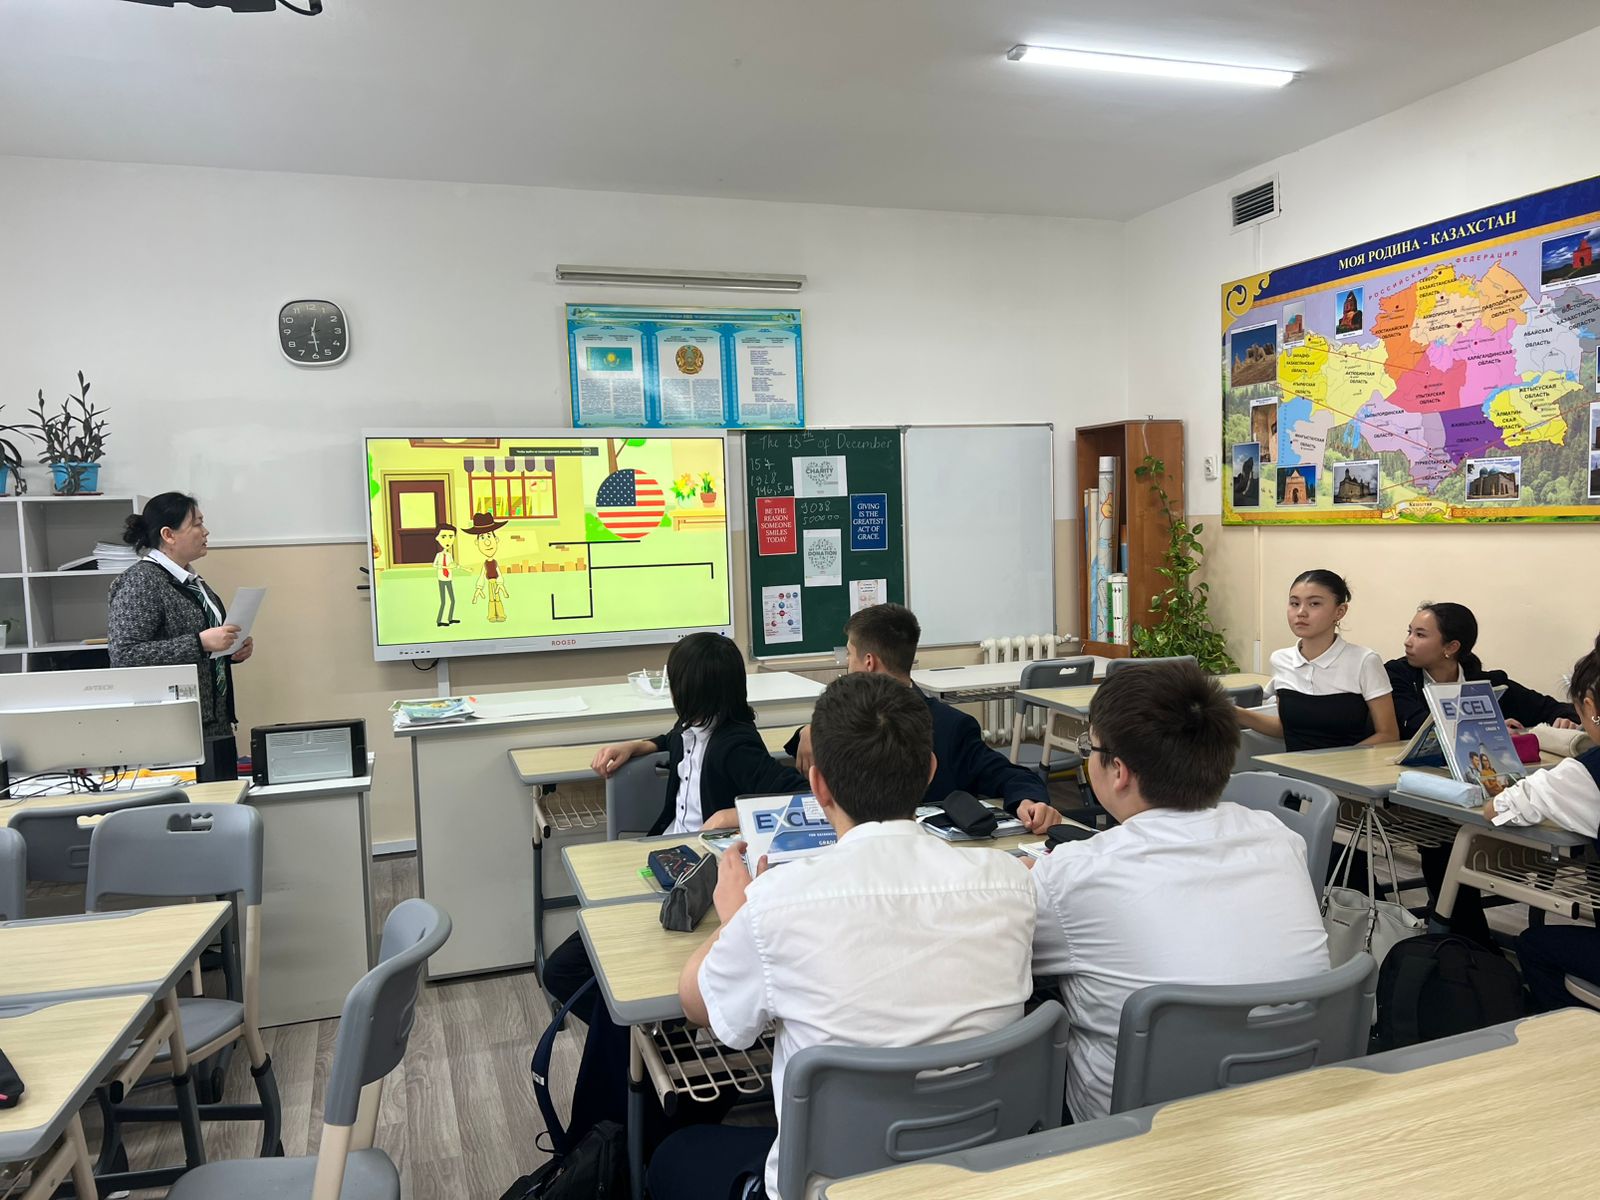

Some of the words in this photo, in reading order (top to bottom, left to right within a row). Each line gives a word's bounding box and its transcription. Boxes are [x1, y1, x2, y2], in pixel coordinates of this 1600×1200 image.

[1338, 254, 1366, 271] МОЯ
[1368, 241, 1420, 263] РОДИНА
[1431, 210, 1517, 246] КАЗАХСТАН
[1368, 266, 1428, 300] РОССИЙСКАЯ
[1455, 250, 1518, 263] ФЕДЕРАЦИЯ
[1491, 308, 1515, 320] ОБЛАСТЬ
[282, 316, 294, 324] 10
[330, 315, 337, 323] 2
[1568, 317, 1596, 331] ОБЛАСТЬ
[1523, 328, 1553, 338] АБАЙСКАЯ
[1525, 340, 1551, 349] ОБЛАСТЬ
[1478, 359, 1501, 367] ОБЛАСТЬ
[760, 434, 779, 450] The
[817, 438, 832, 456] of
[837, 432, 894, 450] December
[806, 467, 834, 475] CHARITY
[857, 502, 880, 510] GIVING
[865, 510, 879, 518] THE
[760, 521, 792, 529] SOMEONE
[853, 517, 885, 525] GREATEST
[857, 525, 870, 533] ACT
[870, 525, 881, 533] OF
[807, 550, 837, 558] DONATION
[1442, 700, 1493, 717] EXCEL
